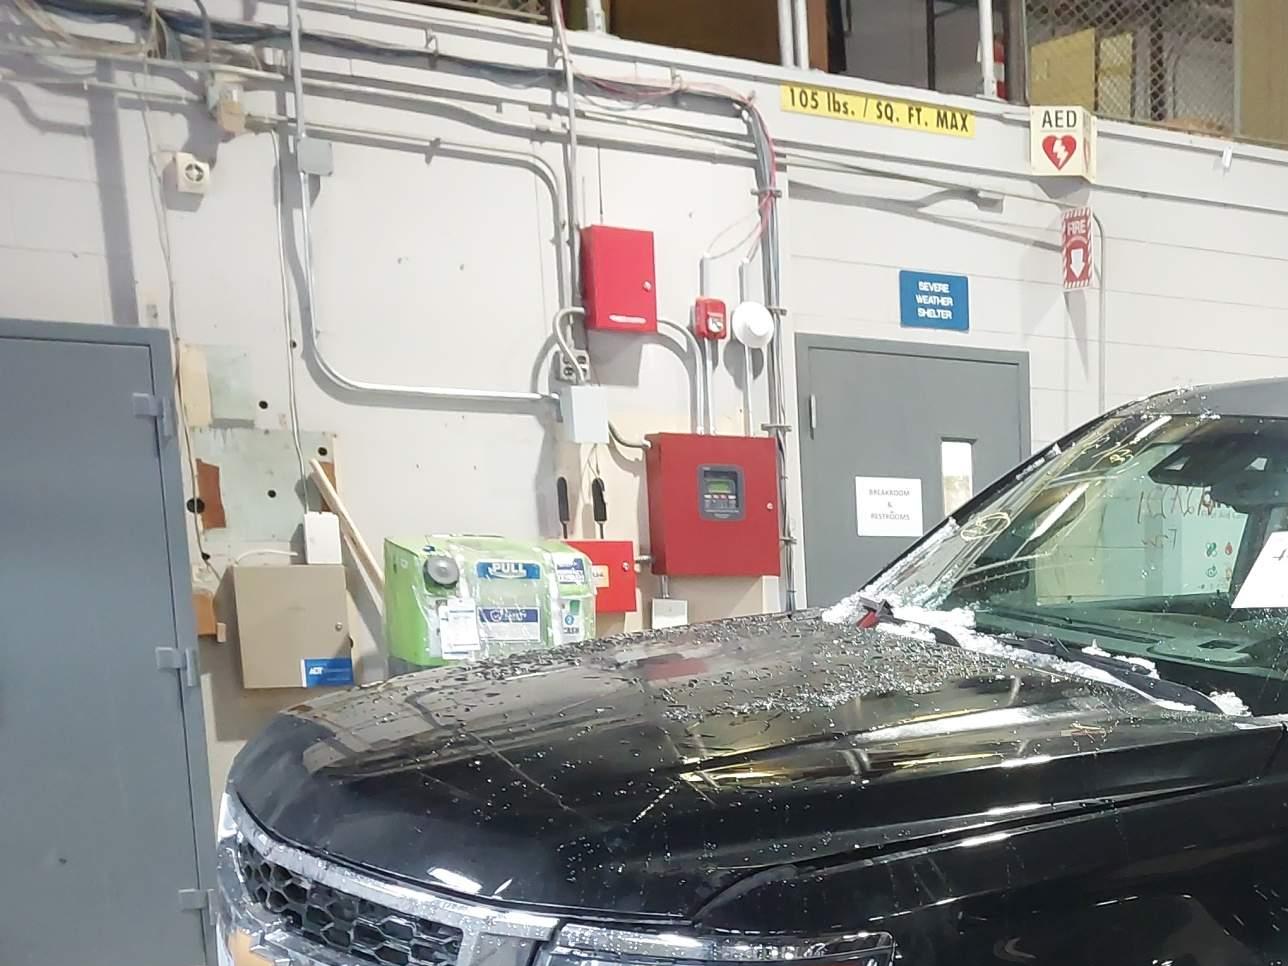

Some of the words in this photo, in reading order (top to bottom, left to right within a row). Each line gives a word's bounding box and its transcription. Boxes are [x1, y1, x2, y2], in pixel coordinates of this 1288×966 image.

[789, 88, 819, 109] 105
[827, 93, 855, 117] lbs.
[862, 97, 869, 118] /
[876, 101, 900, 123] SQ.
[908, 104, 929, 127] FT.
[935, 110, 969, 133] MAX
[1041, 109, 1077, 129] AED
[1067, 219, 1087, 236] FIRE
[918, 280, 951, 294] SEVERE
[915, 293, 954, 307] WEATHER
[917, 306, 953, 320] SHELTER
[868, 488, 911, 497] BREAKROOM
[870, 512, 911, 521] RESTROOMS
[492, 561, 527, 573] PULL
